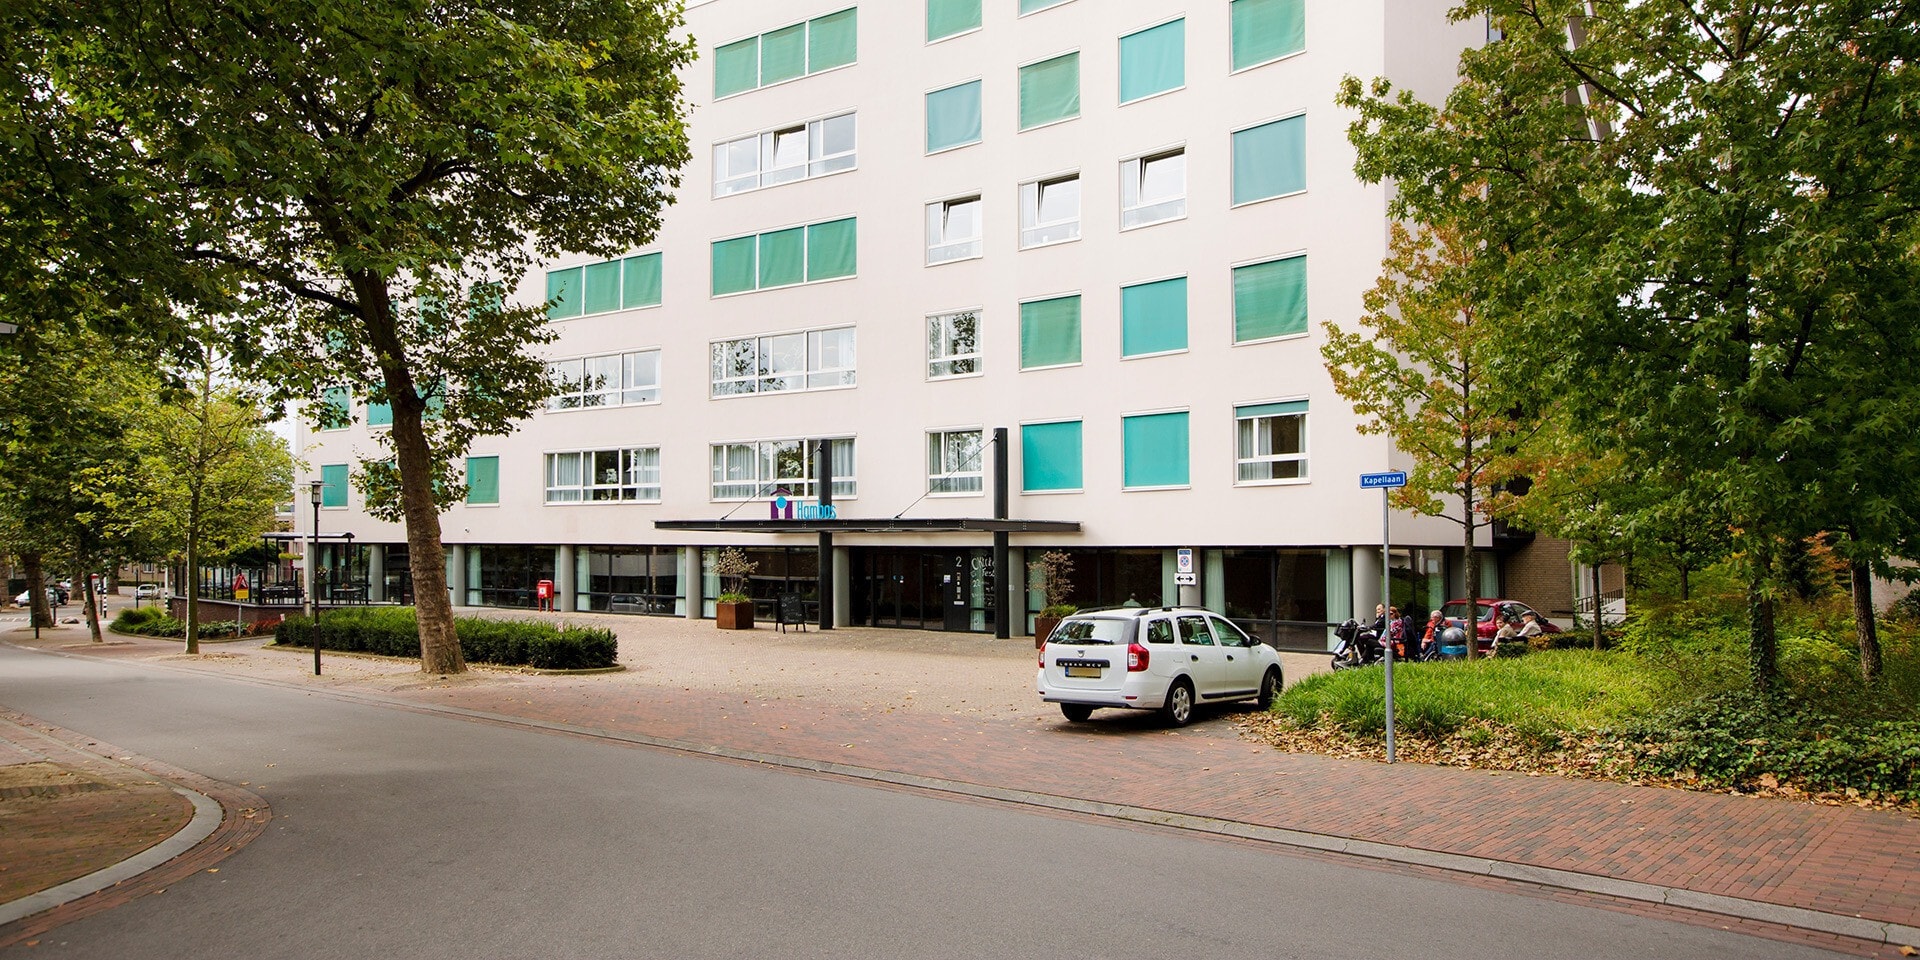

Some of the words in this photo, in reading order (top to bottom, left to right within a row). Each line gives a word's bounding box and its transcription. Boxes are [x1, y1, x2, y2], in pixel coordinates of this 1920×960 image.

[1363, 476, 1401, 485] Kapellaan
[797, 500, 837, 519] Hambos
[955, 556, 963, 568] 2
